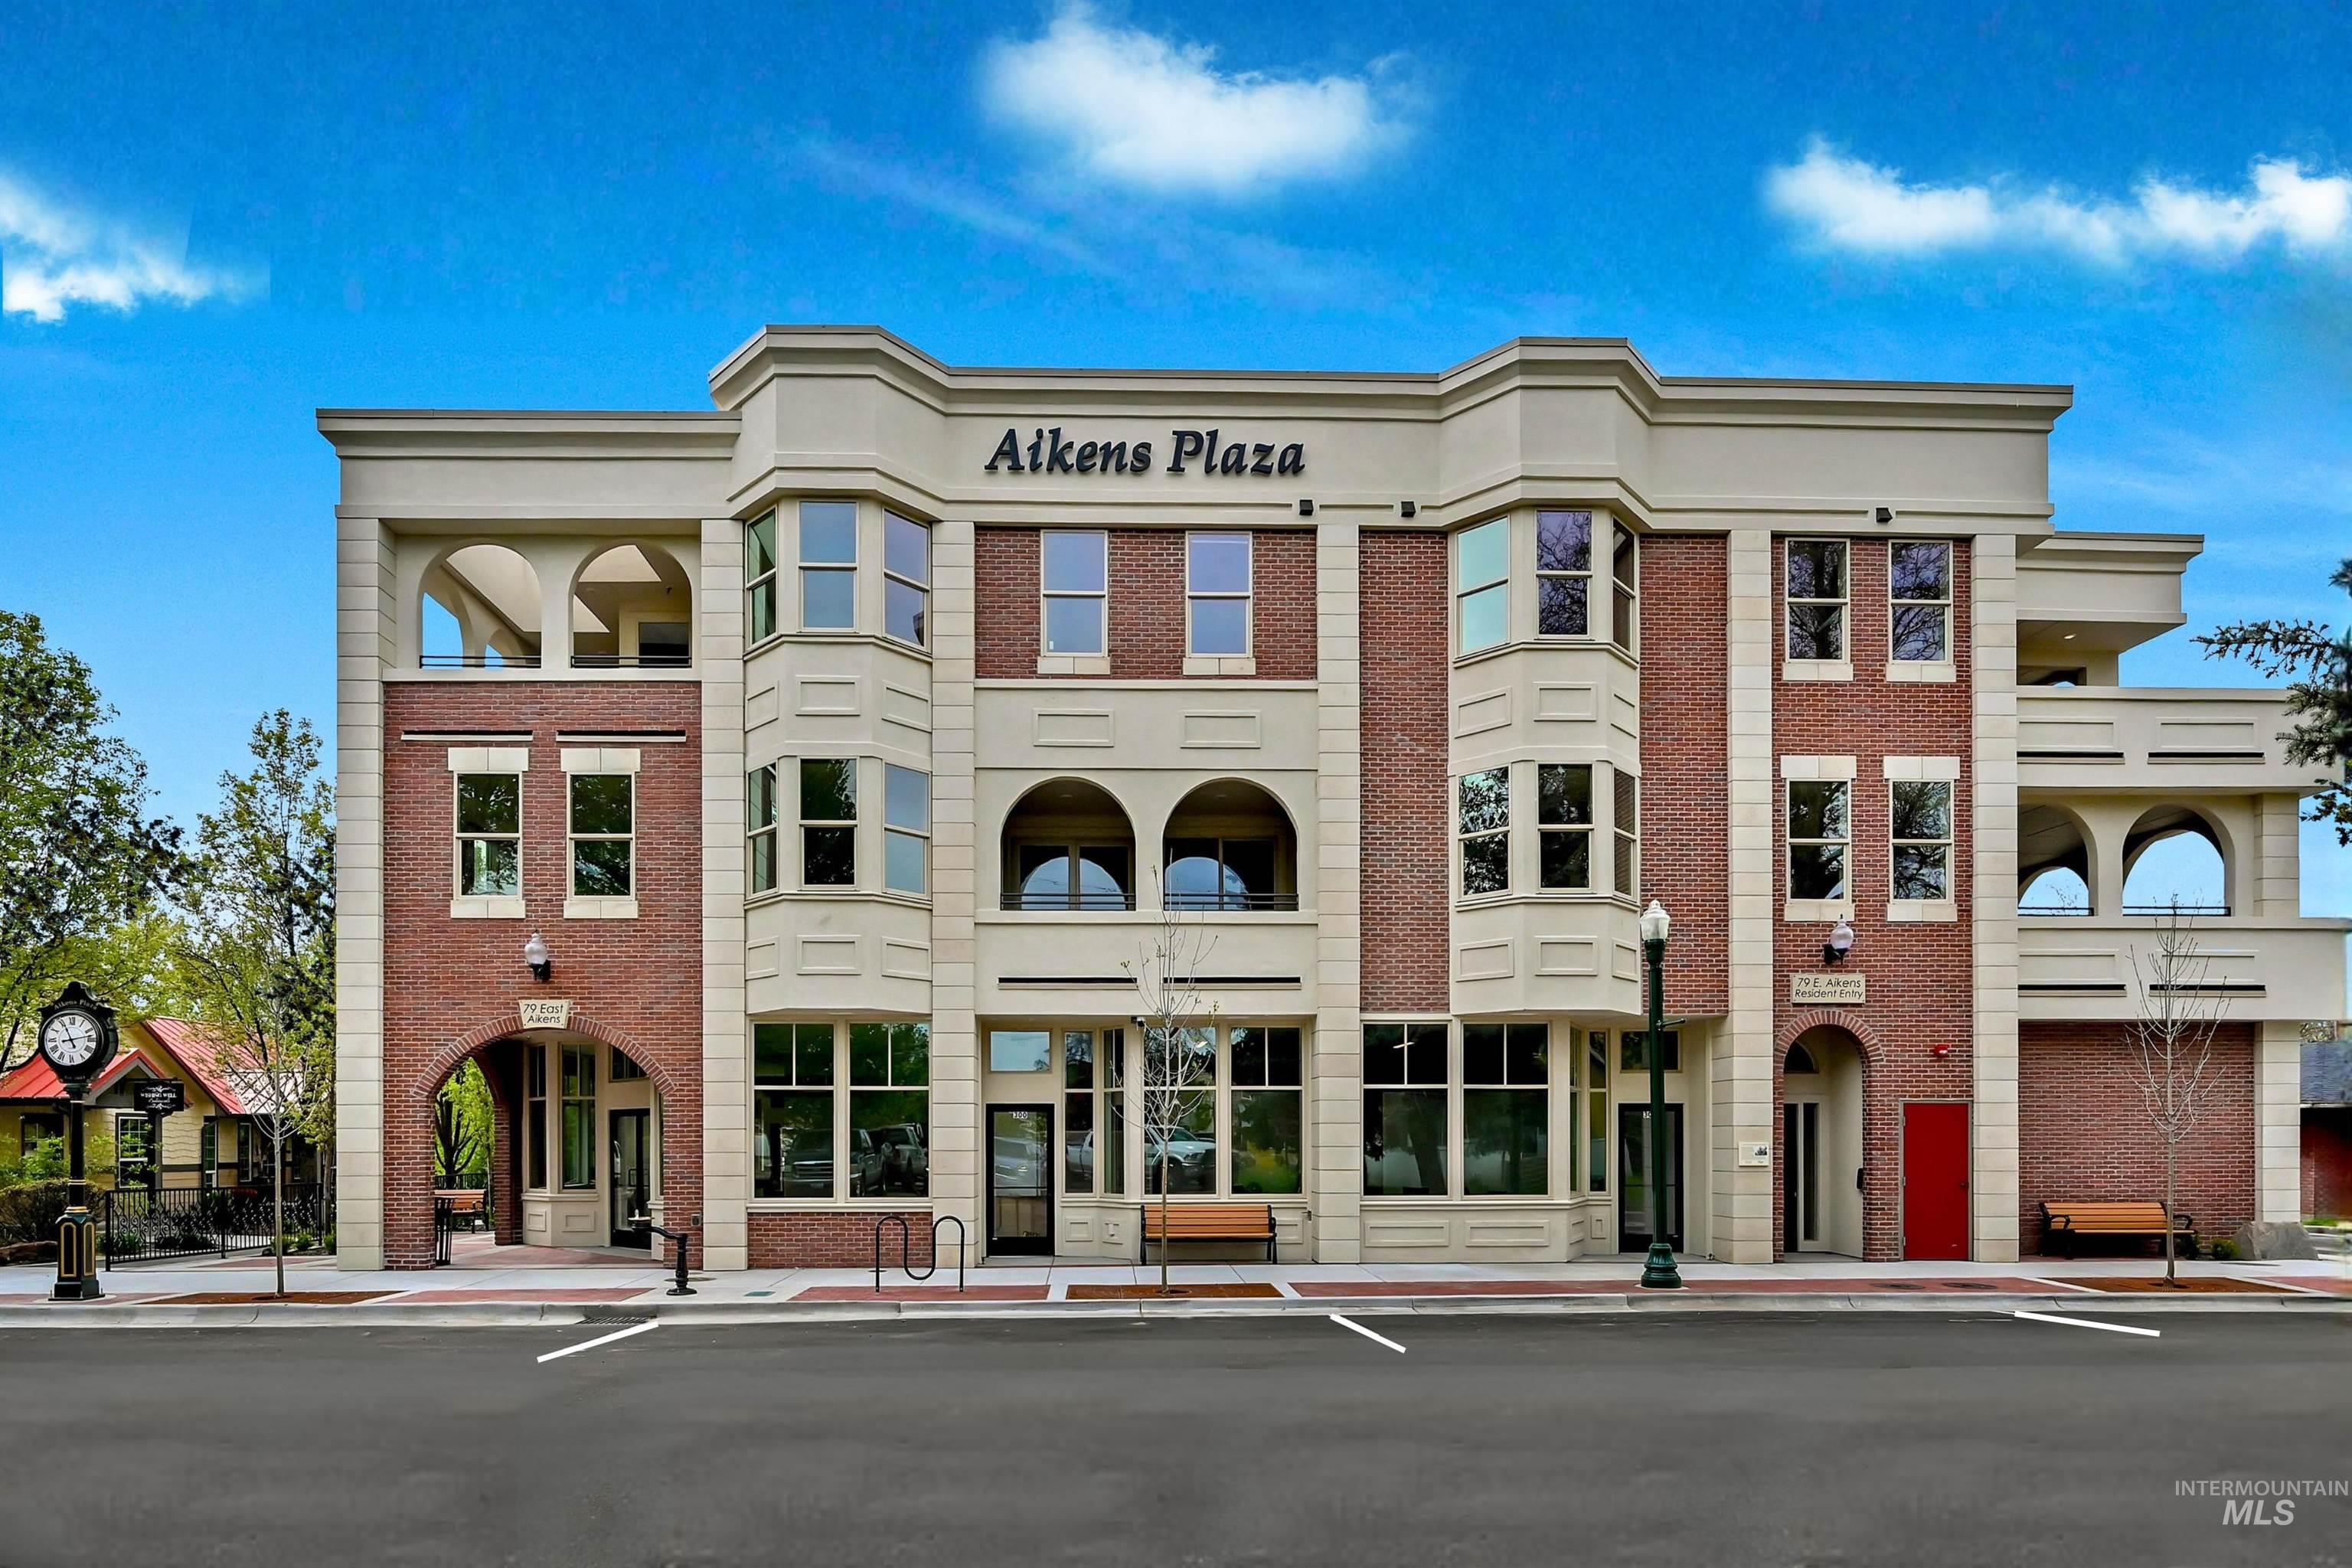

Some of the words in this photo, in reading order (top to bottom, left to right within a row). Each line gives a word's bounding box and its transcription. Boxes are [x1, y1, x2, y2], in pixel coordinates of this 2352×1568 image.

[985, 426, 1152, 473] Aikens
[1166, 429, 1306, 475] Plaza
[1798, 978, 1811, 988] 79
[1813, 978, 1822, 988] E.
[1825, 977, 1861, 988] Aikens
[1795, 988, 1837, 998] Resident
[1839, 989, 1863, 1000] Entry
[524, 1004, 537, 1014] 79
[540, 1004, 564, 1014] East
[527, 1014, 560, 1024] Aikens
